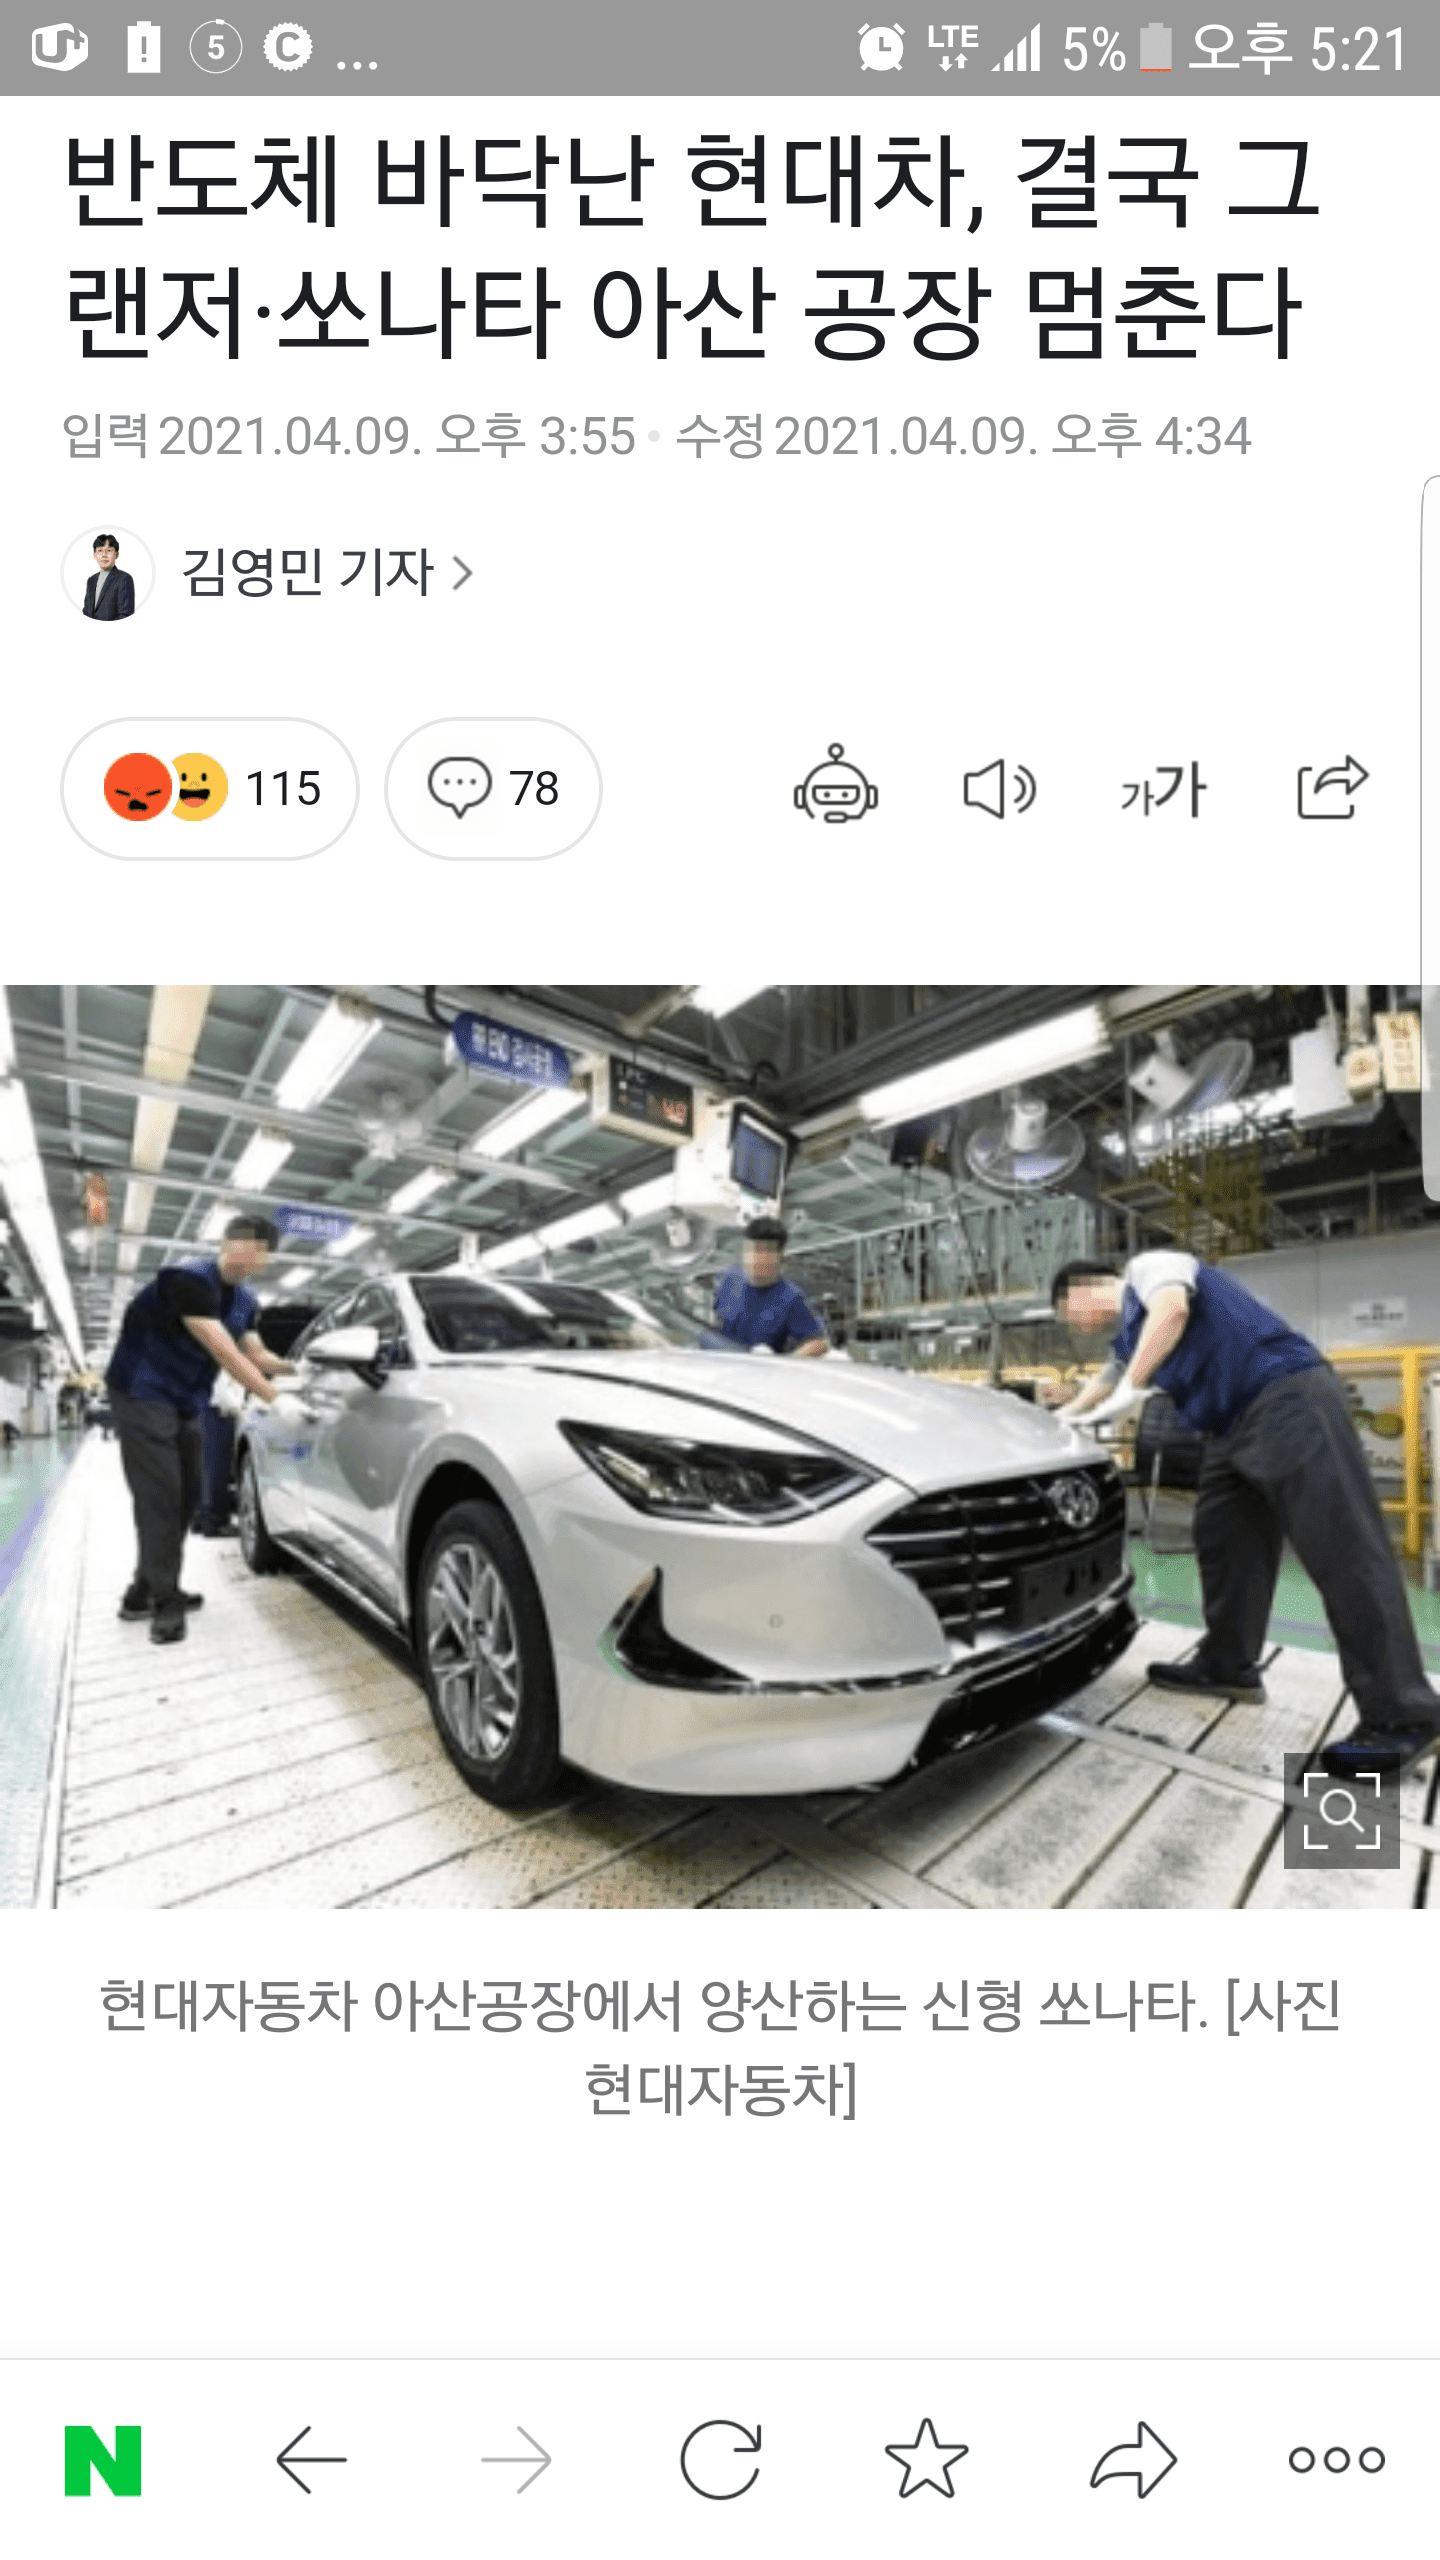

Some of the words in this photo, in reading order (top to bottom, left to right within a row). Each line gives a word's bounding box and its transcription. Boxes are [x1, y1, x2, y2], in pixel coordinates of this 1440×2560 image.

[207, 35, 226, 61] 5
[928, 24, 979, 48] LTE
[1063, 26, 1127, 72] 5%
[1188, 22, 1293, 76] 오후
[1311, 26, 1402, 72] 5:21
[68, 134, 336, 228] 반도체
[377, 134, 655, 229] 바닥난
[686, 134, 983, 235] 현대차,
[1016, 134, 1199, 229] 결국
[1228, 141, 1320, 215] 그
[69, 266, 562, 360] 랜저·쏘나타
[593, 266, 777, 360] 아산
[804, 266, 993, 362] 공장
[1028, 266, 1303, 360] 멈춘다
[63, 413, 146, 459] 입력
[159, 415, 421, 456] 2021.04.09.
[435, 412, 526, 459] 오후
[540, 415, 636, 456] 3:55
[676, 413, 763, 460] 수정
[775, 415, 1037, 456] 2021.04.09.
[1051, 412, 1142, 459] 오후
[1155, 415, 1252, 456] 4:34
[182, 547, 322, 597] 김영민
[339, 547, 435, 597] 기자
[247, 770, 321, 806] 115
[509, 770, 559, 806] 78
[100, 1979, 359, 2034] 현대자동차
[374, 1979, 680, 2034] 아산공장에서
[701, 1979, 907, 2034] 양산하는
[922, 1979, 1021, 2034] 신형
[1039, 1980, 1208, 2033] 쏘나타.
[1227, 1977, 1339, 2037] [사진
[585, 2061, 856, 2121] 현대자동차]
[64, 2425, 142, 2498] N
